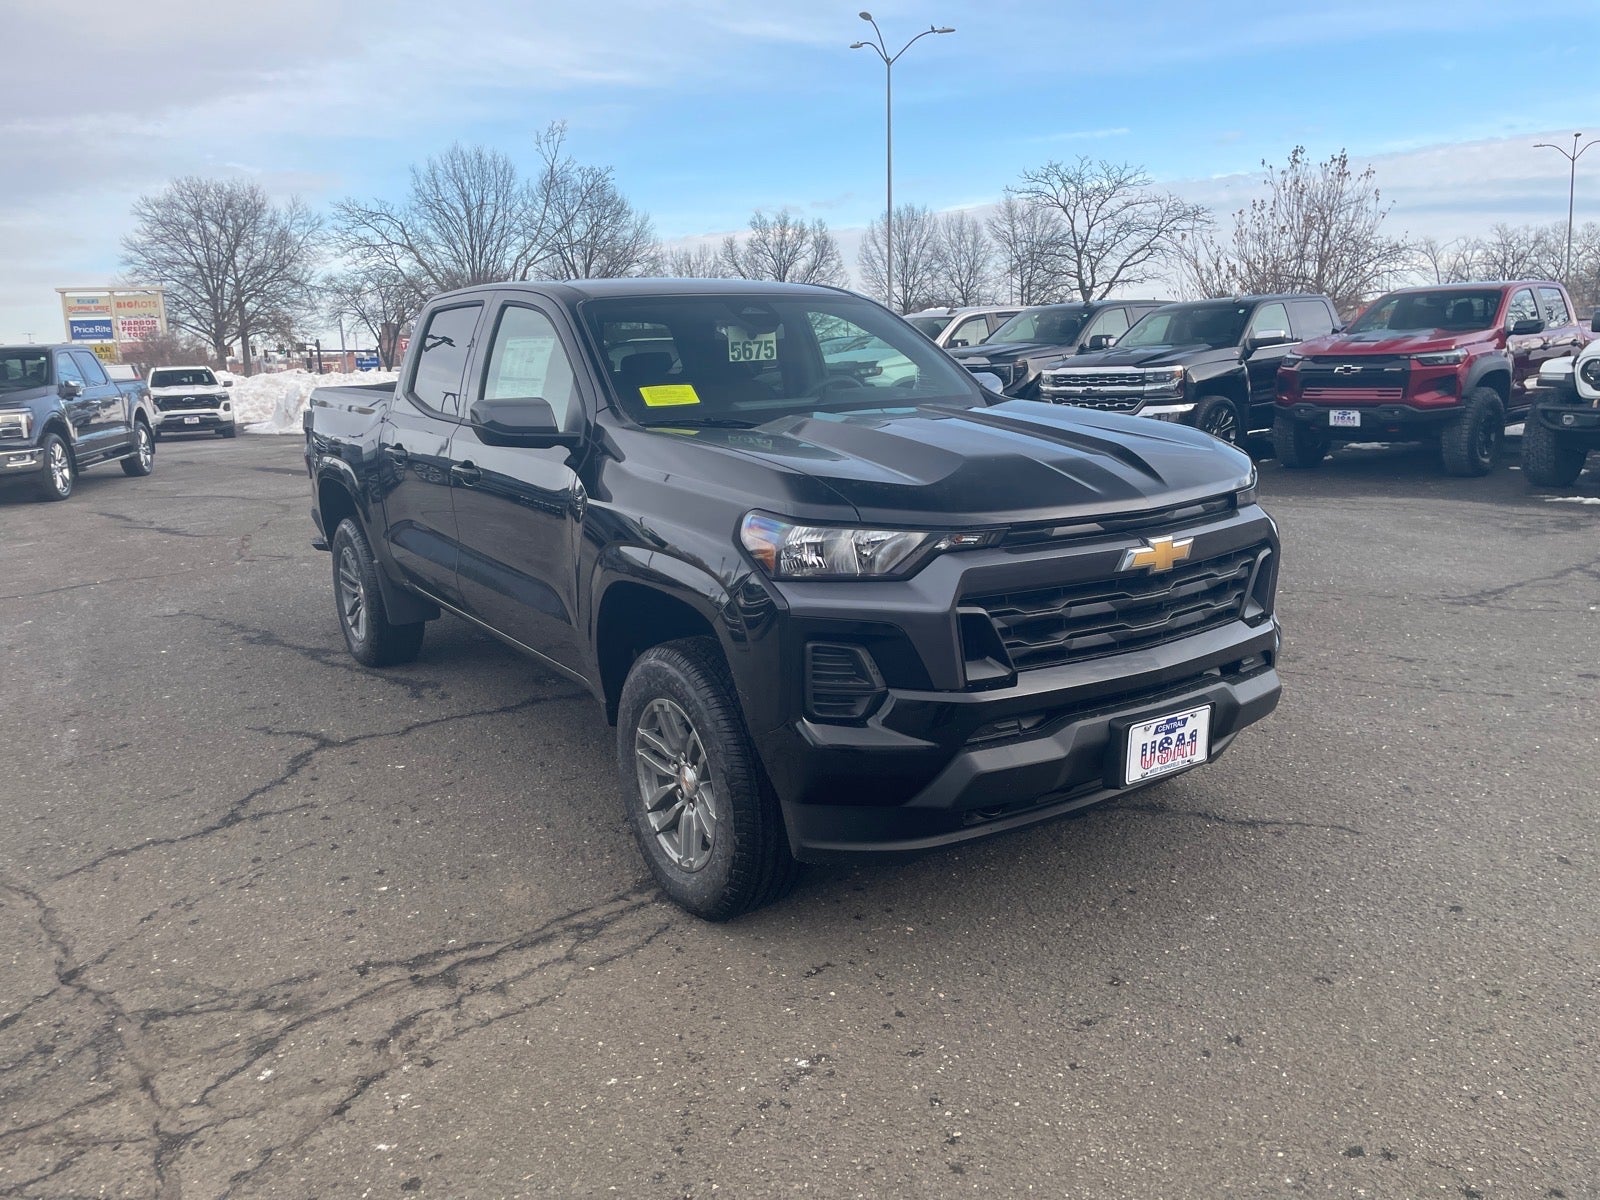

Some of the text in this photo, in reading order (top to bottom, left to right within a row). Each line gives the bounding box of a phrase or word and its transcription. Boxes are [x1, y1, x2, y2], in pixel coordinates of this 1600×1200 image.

[73, 325, 111, 333] Price Rite
[730, 339, 775, 361] 5675
[1157, 720, 1184, 732] CENTRAL
